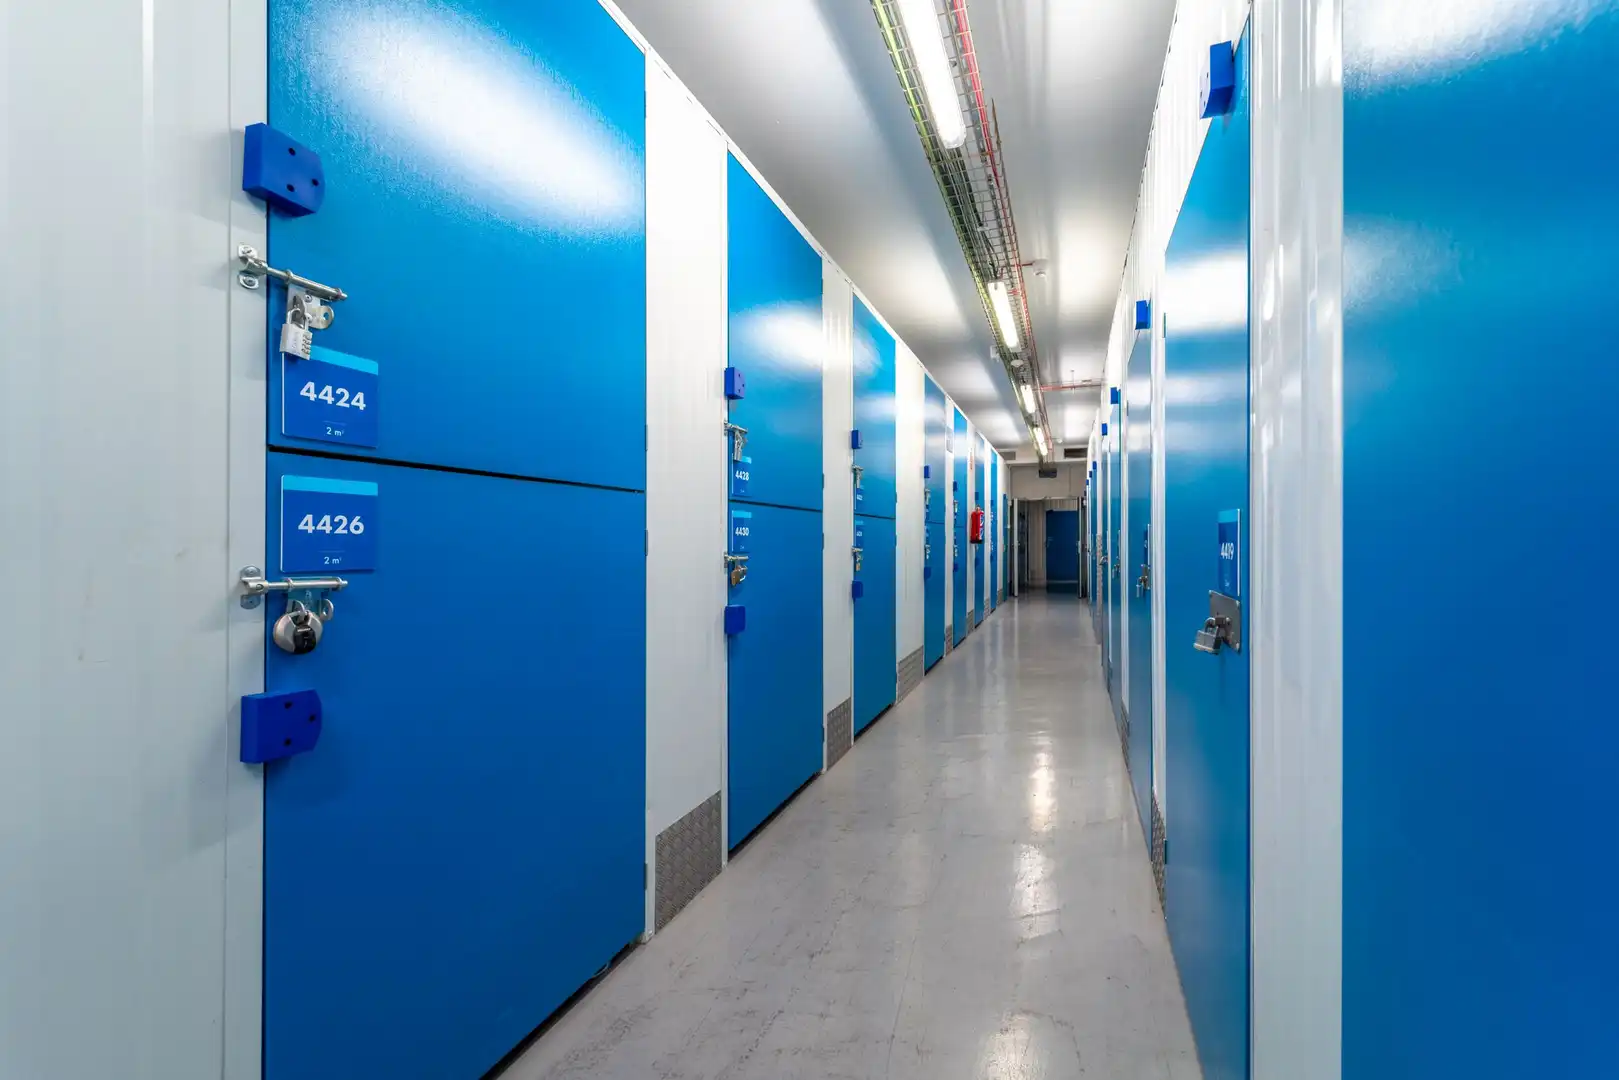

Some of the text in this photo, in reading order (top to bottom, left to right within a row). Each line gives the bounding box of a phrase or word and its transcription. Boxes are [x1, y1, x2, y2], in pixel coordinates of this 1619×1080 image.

[300, 381, 366, 411] 4424
[326, 427, 332, 436] 2
[735, 470, 750, 481] 4428
[298, 514, 365, 535] 4426
[735, 527, 750, 537] 4430
[324, 557, 330, 565] 2
